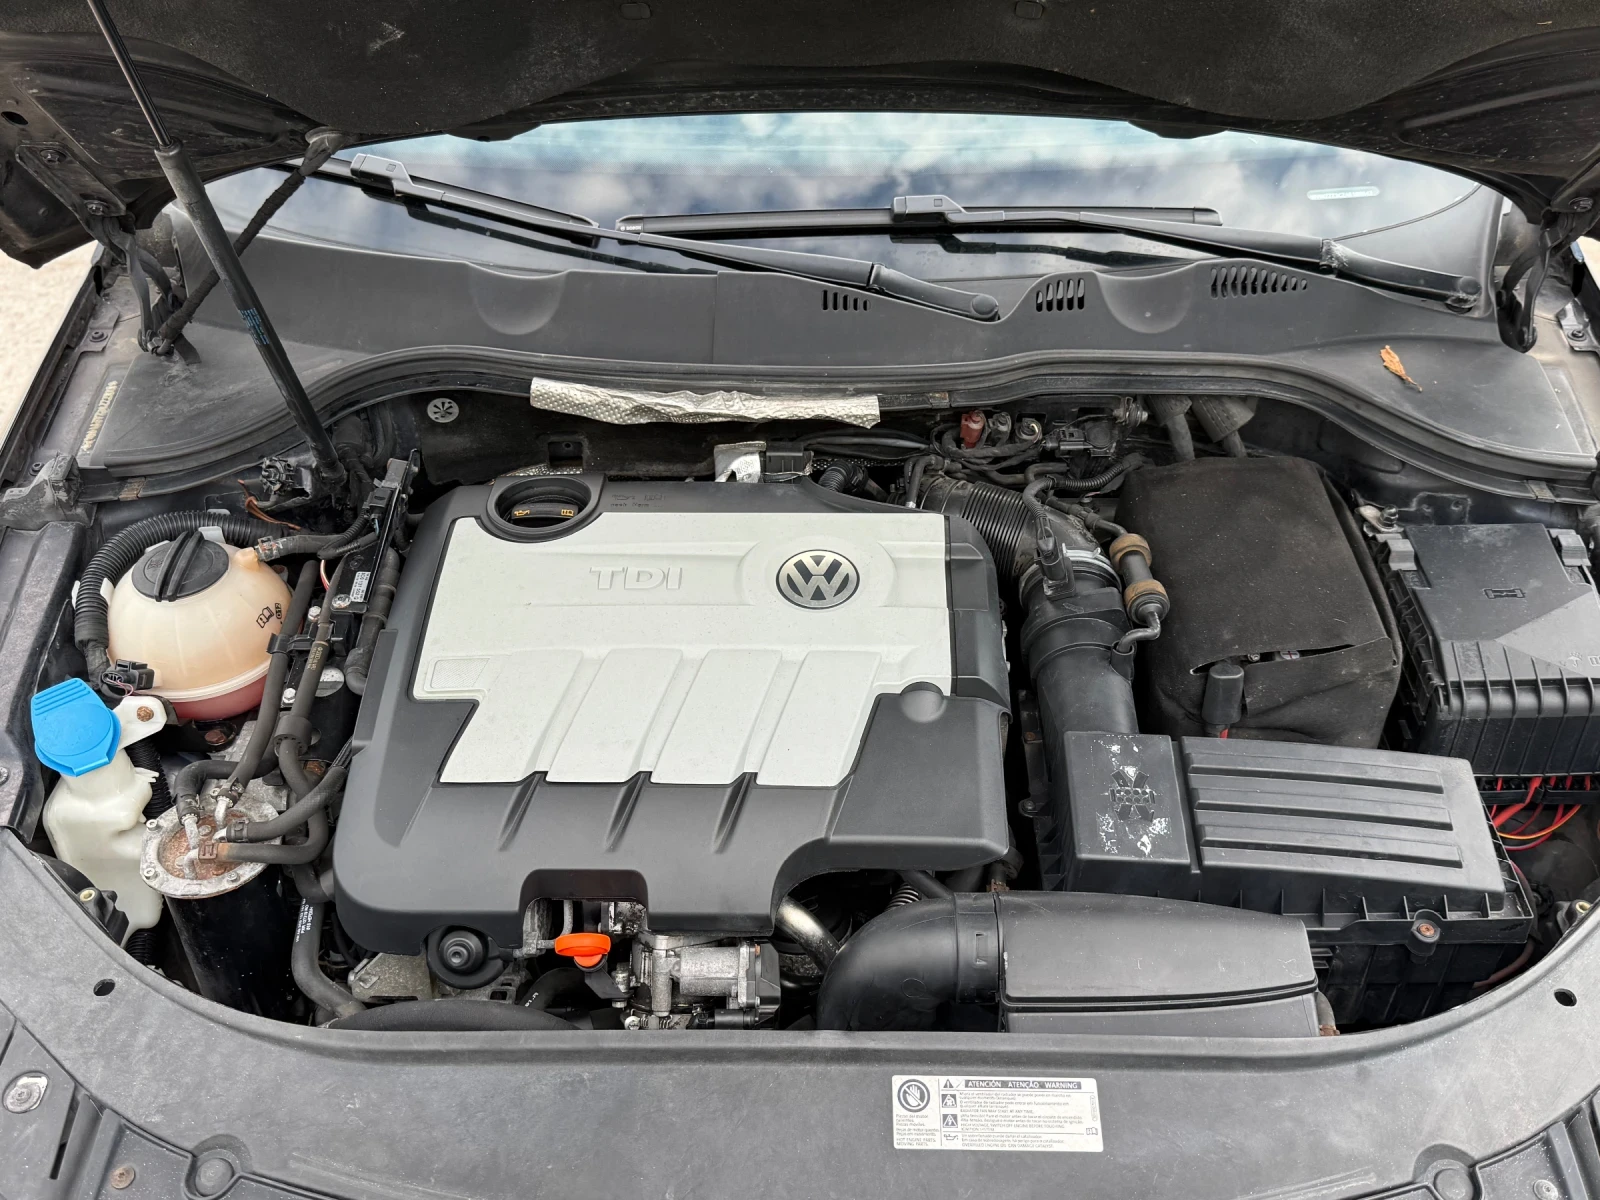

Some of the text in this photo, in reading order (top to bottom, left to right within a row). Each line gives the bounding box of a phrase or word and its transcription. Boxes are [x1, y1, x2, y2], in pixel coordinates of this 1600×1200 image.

[589, 549, 860, 610] TDI VW
[1008, 1080, 1039, 1089] ATENÇÃO
